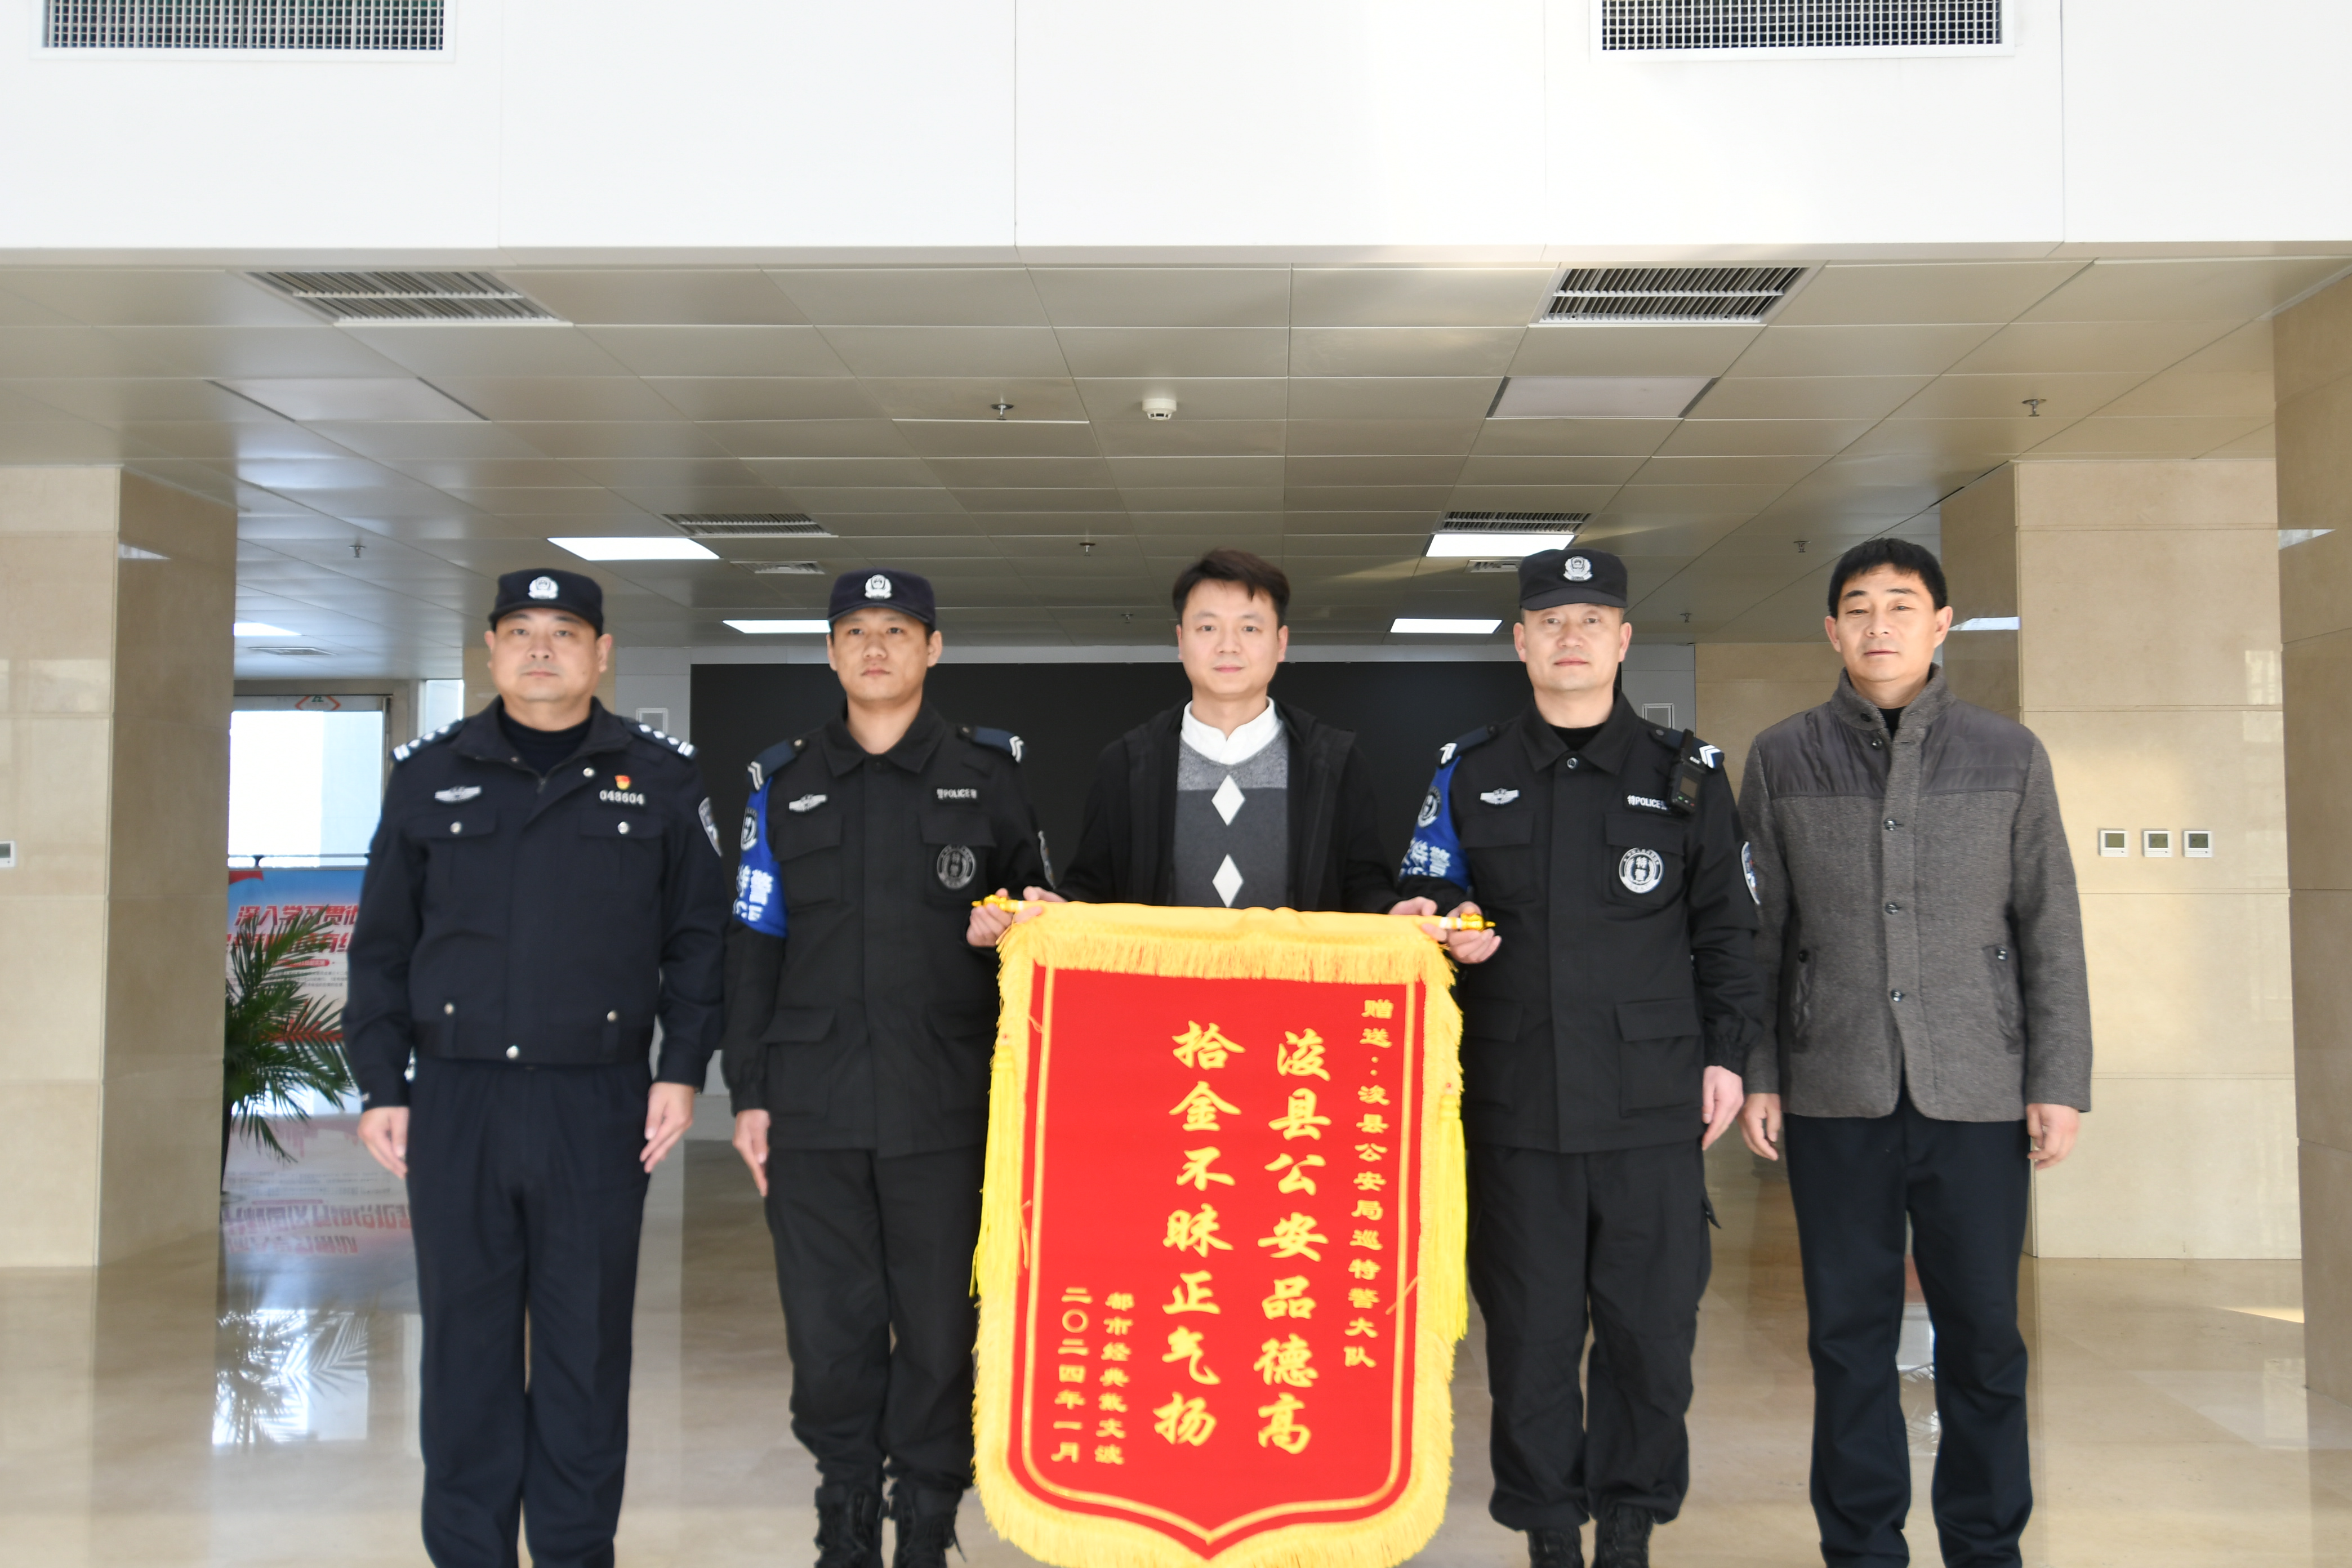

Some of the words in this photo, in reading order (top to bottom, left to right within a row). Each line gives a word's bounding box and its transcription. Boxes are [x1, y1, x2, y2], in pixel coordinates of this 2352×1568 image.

[1152, 1020, 1245, 1446] 拾金不昧正气扬
[1253, 1028, 1331, 1455] 浚县公安品德高
